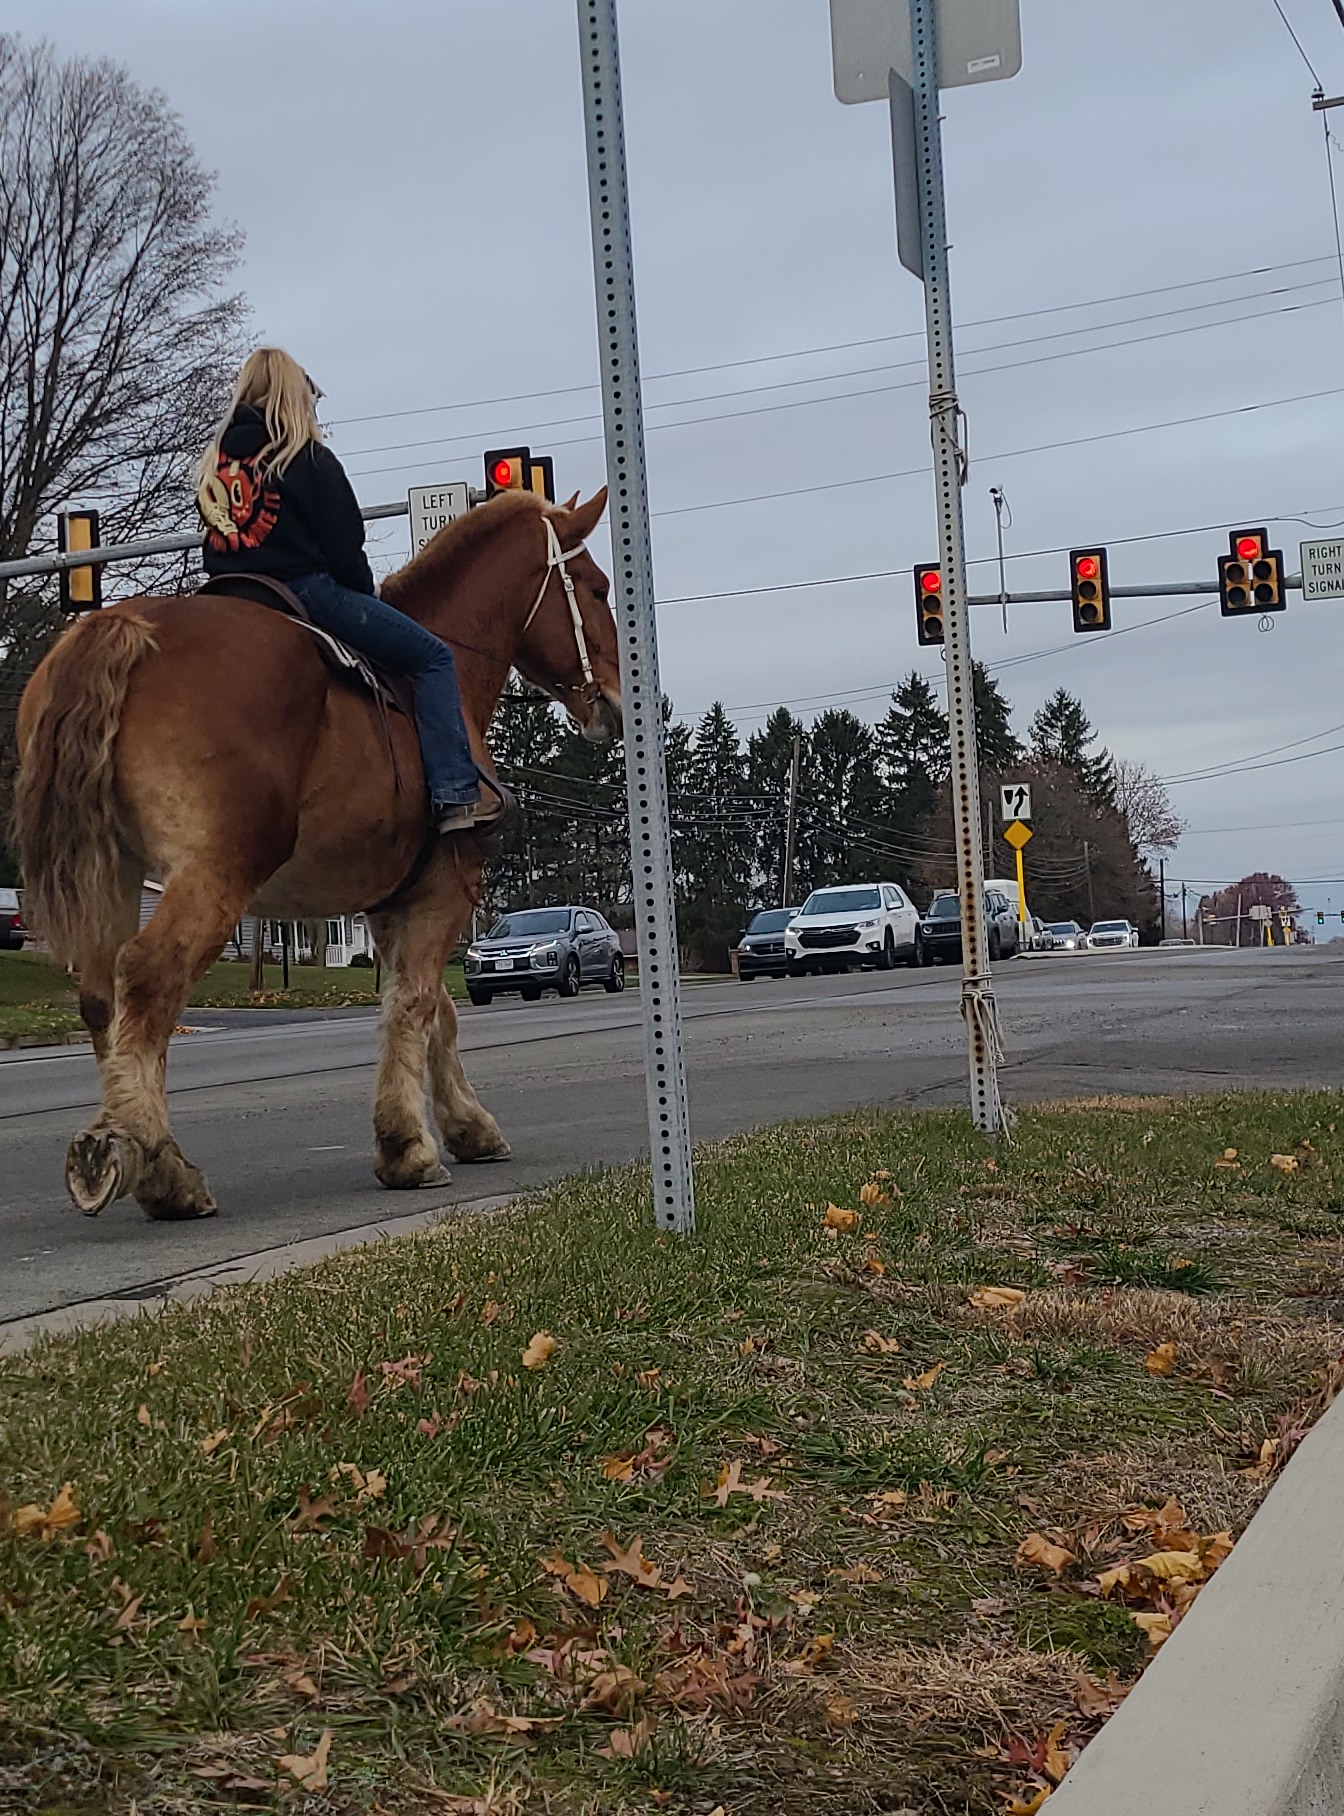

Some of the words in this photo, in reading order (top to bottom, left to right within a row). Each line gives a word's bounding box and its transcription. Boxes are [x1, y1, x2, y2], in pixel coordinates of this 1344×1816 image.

[423, 493, 453, 509] LEFT
[1308, 545, 1342, 560] RIGHT
[1311, 562, 1342, 577] TURN
